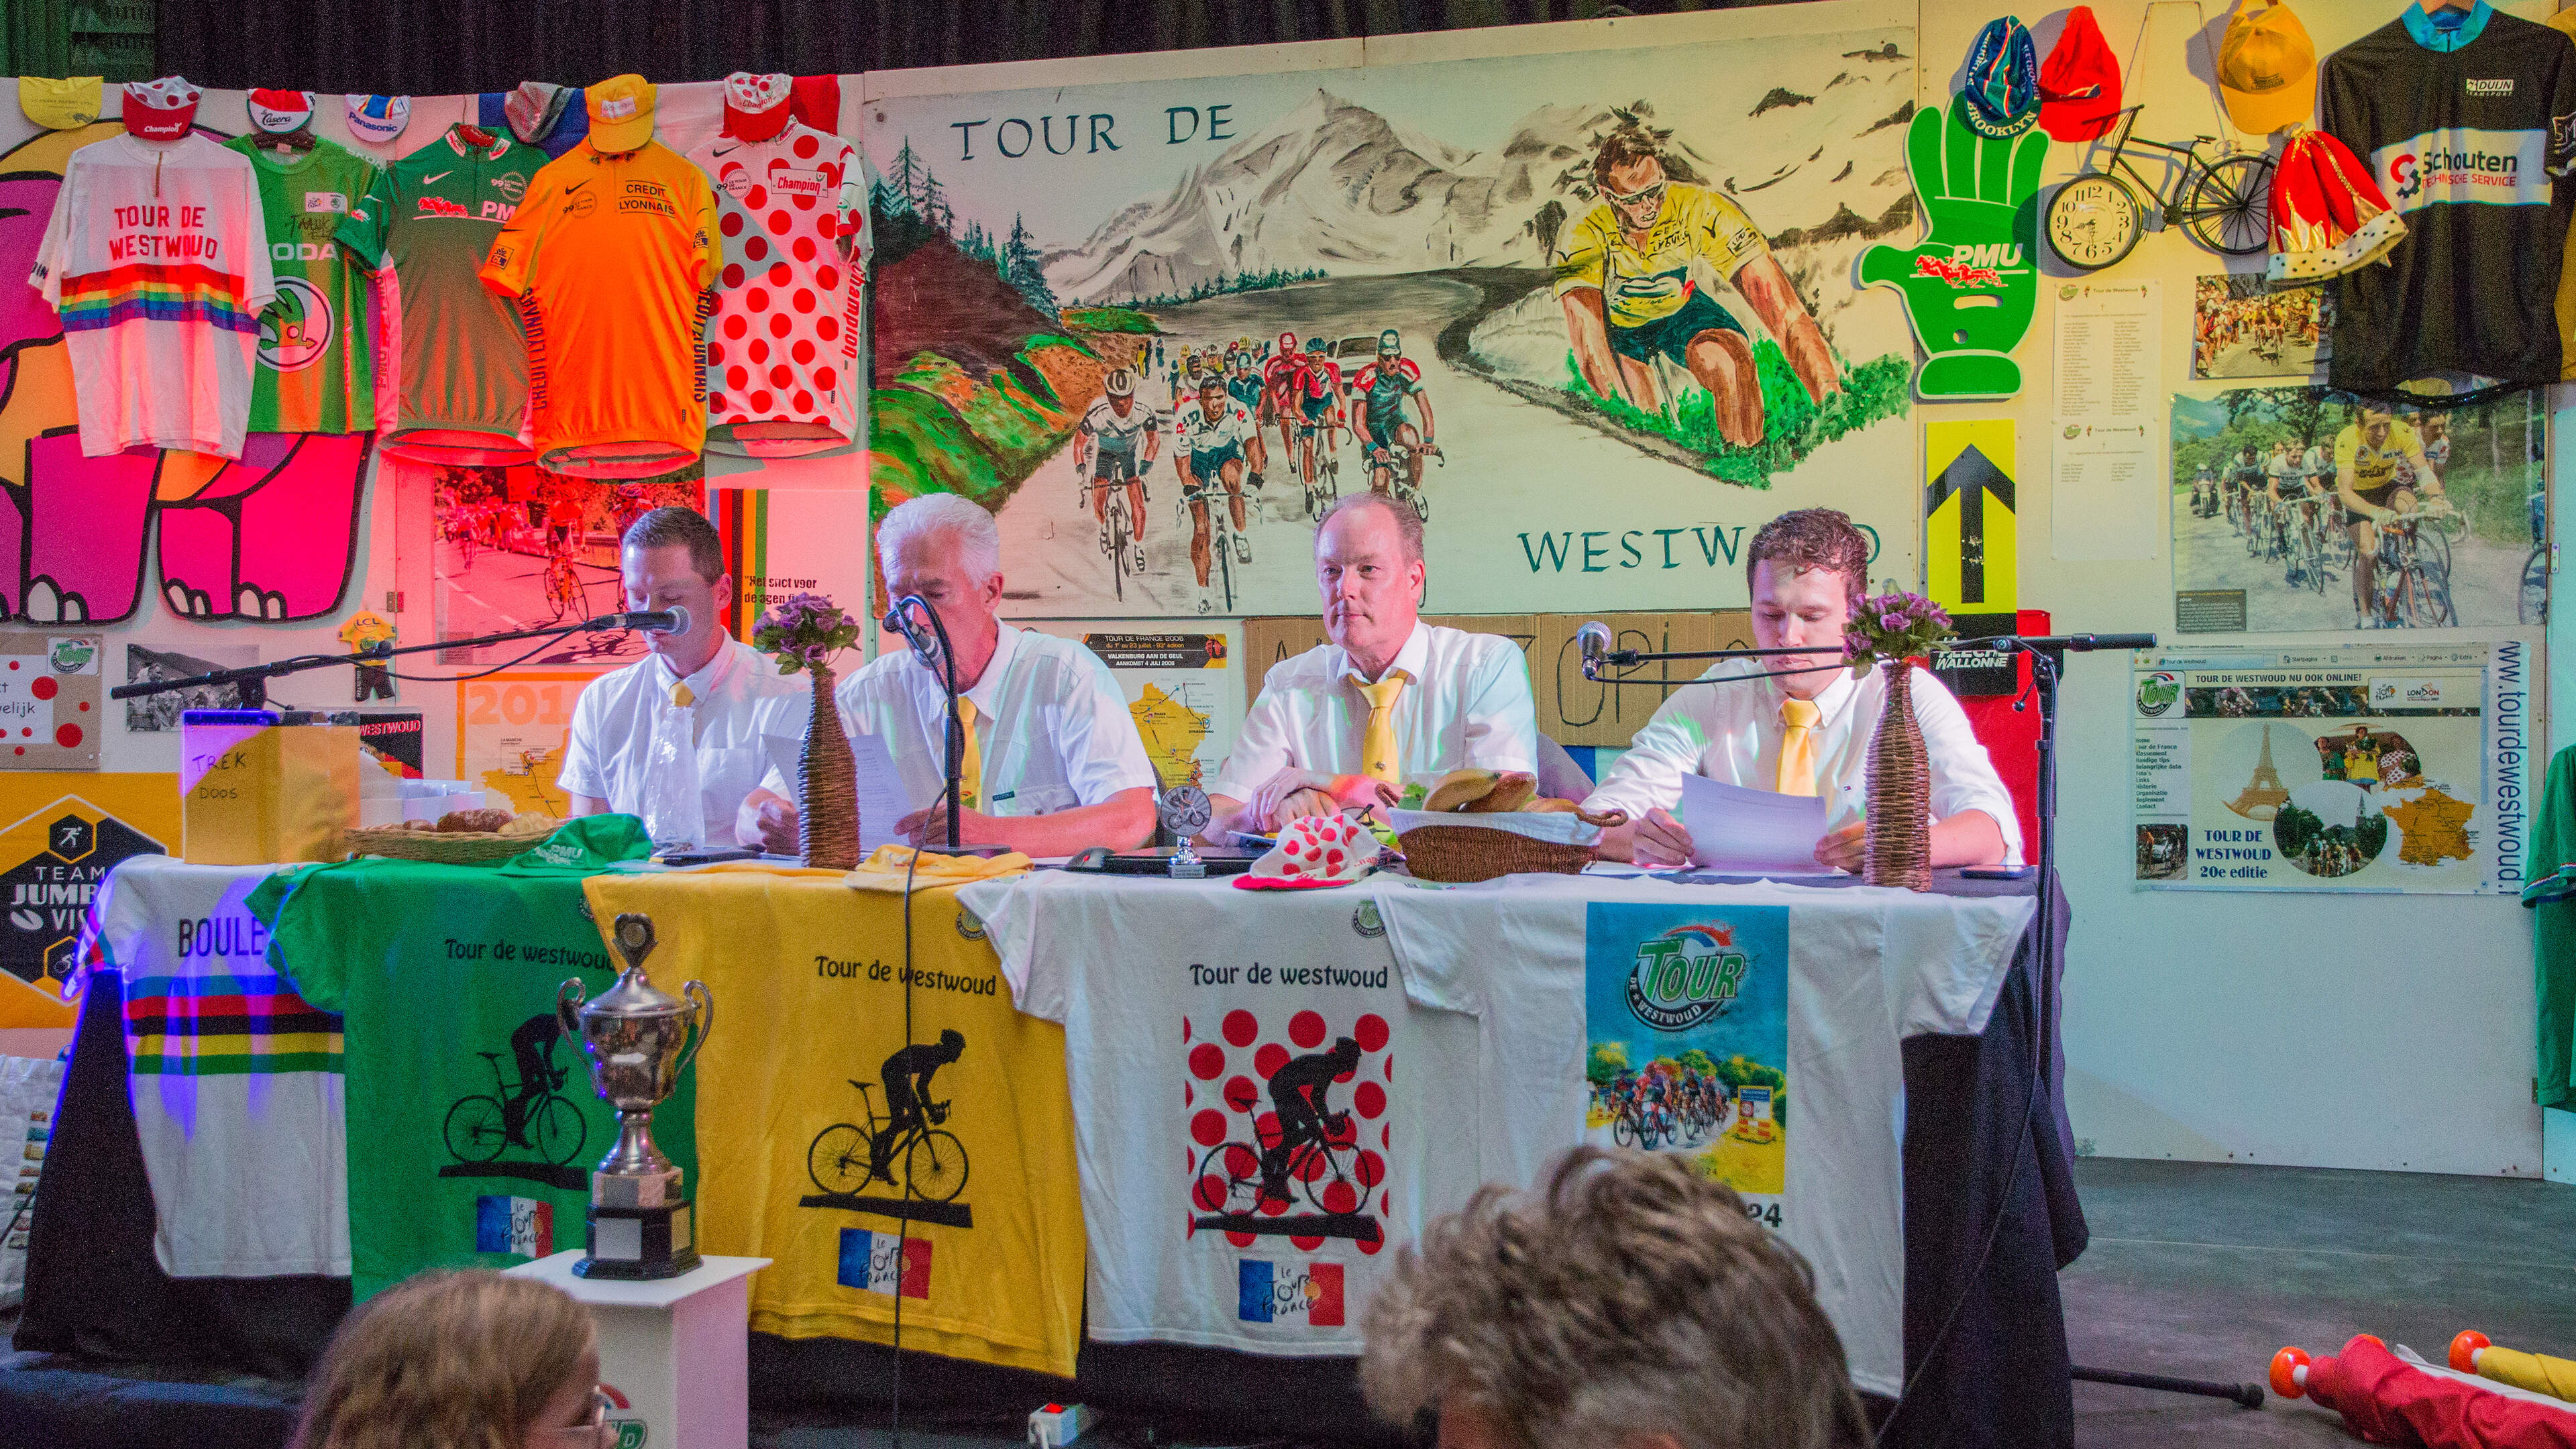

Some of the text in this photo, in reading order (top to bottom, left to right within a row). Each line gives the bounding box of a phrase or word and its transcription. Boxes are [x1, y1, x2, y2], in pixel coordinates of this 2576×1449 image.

[348, 111, 398, 132] Panasonic
[1967, 101, 2037, 136] BROOKLYN
[144, 123, 179, 133] Champion
[949, 104, 1238, 162] TOUR DE
[2423, 147, 2518, 174] Schouten
[716, 183, 728, 191] 99
[777, 176, 821, 195] Champion
[2471, 173, 2517, 186] SERVICE
[625, 184, 666, 198] CREDIT
[2076, 189, 2085, 202] 11
[2088, 185, 2102, 199] 12
[2108, 191, 2112, 203] 1
[480, 201, 517, 221] PM
[619, 199, 676, 215] LYONNAIS
[2061, 201, 2076, 213] 10
[2116, 201, 2127, 215] 2
[114, 205, 207, 229] TOUR DE
[2057, 215, 2068, 229] 9
[2119, 215, 2129, 229] 3
[2059, 230, 2072, 244] 8
[2112, 230, 2122, 243] 4
[109, 235, 218, 262] WESTWOUD
[272, 242, 339, 262] ODA
[1952, 243, 2024, 268] PMU
[2072, 242, 2082, 255] 7
[2085, 244, 2097, 259] 6
[2101, 241, 2112, 256] 5
[841, 264, 866, 360] Champion
[529, 356, 547, 411] CREDIT
[1517, 523, 1880, 574] WESTWD
[794, 579, 817, 589] voor
[744, 592, 757, 603] de
[356, 617, 381, 627] LCL
[1935, 656, 2008, 670] WALLONNE
[2195, 675, 2218, 683] TOUR
[2235, 674, 2286, 682] WESTWOUD
[2289, 674, 2302, 682] NU
[2305, 674, 2322, 682] OOK
[2326, 673, 2362, 682] ONLINE!
[2139, 678, 2180, 704] TOUR
[2406, 687, 2440, 697] LONDON
[468, 684, 570, 725] 201
[360, 719, 421, 737] WESTWOUD
[192, 751, 246, 773] TREK
[2498, 641, 2528, 895] ww.tourdewestwoud.
[199, 787, 238, 800] DOOS
[2204, 830, 2263, 842] TOUR DE
[2195, 848, 2272, 860] WESTWOUD
[35, 866, 105, 881] TEAM
[2200, 865, 2268, 879] 20e editie
[11, 883, 102, 906] JUMB
[445, 938, 487, 959] Tour
[493, 939, 515, 960] de
[815, 955, 997, 997] Tour de westwoud
[1189, 963, 1388, 989] Tour de westwoud
[1636, 938, 1747, 1002] TOUR
[1637, 997, 1702, 1025] WESTWOUD
[1746, 1201, 1782, 1228] 24
